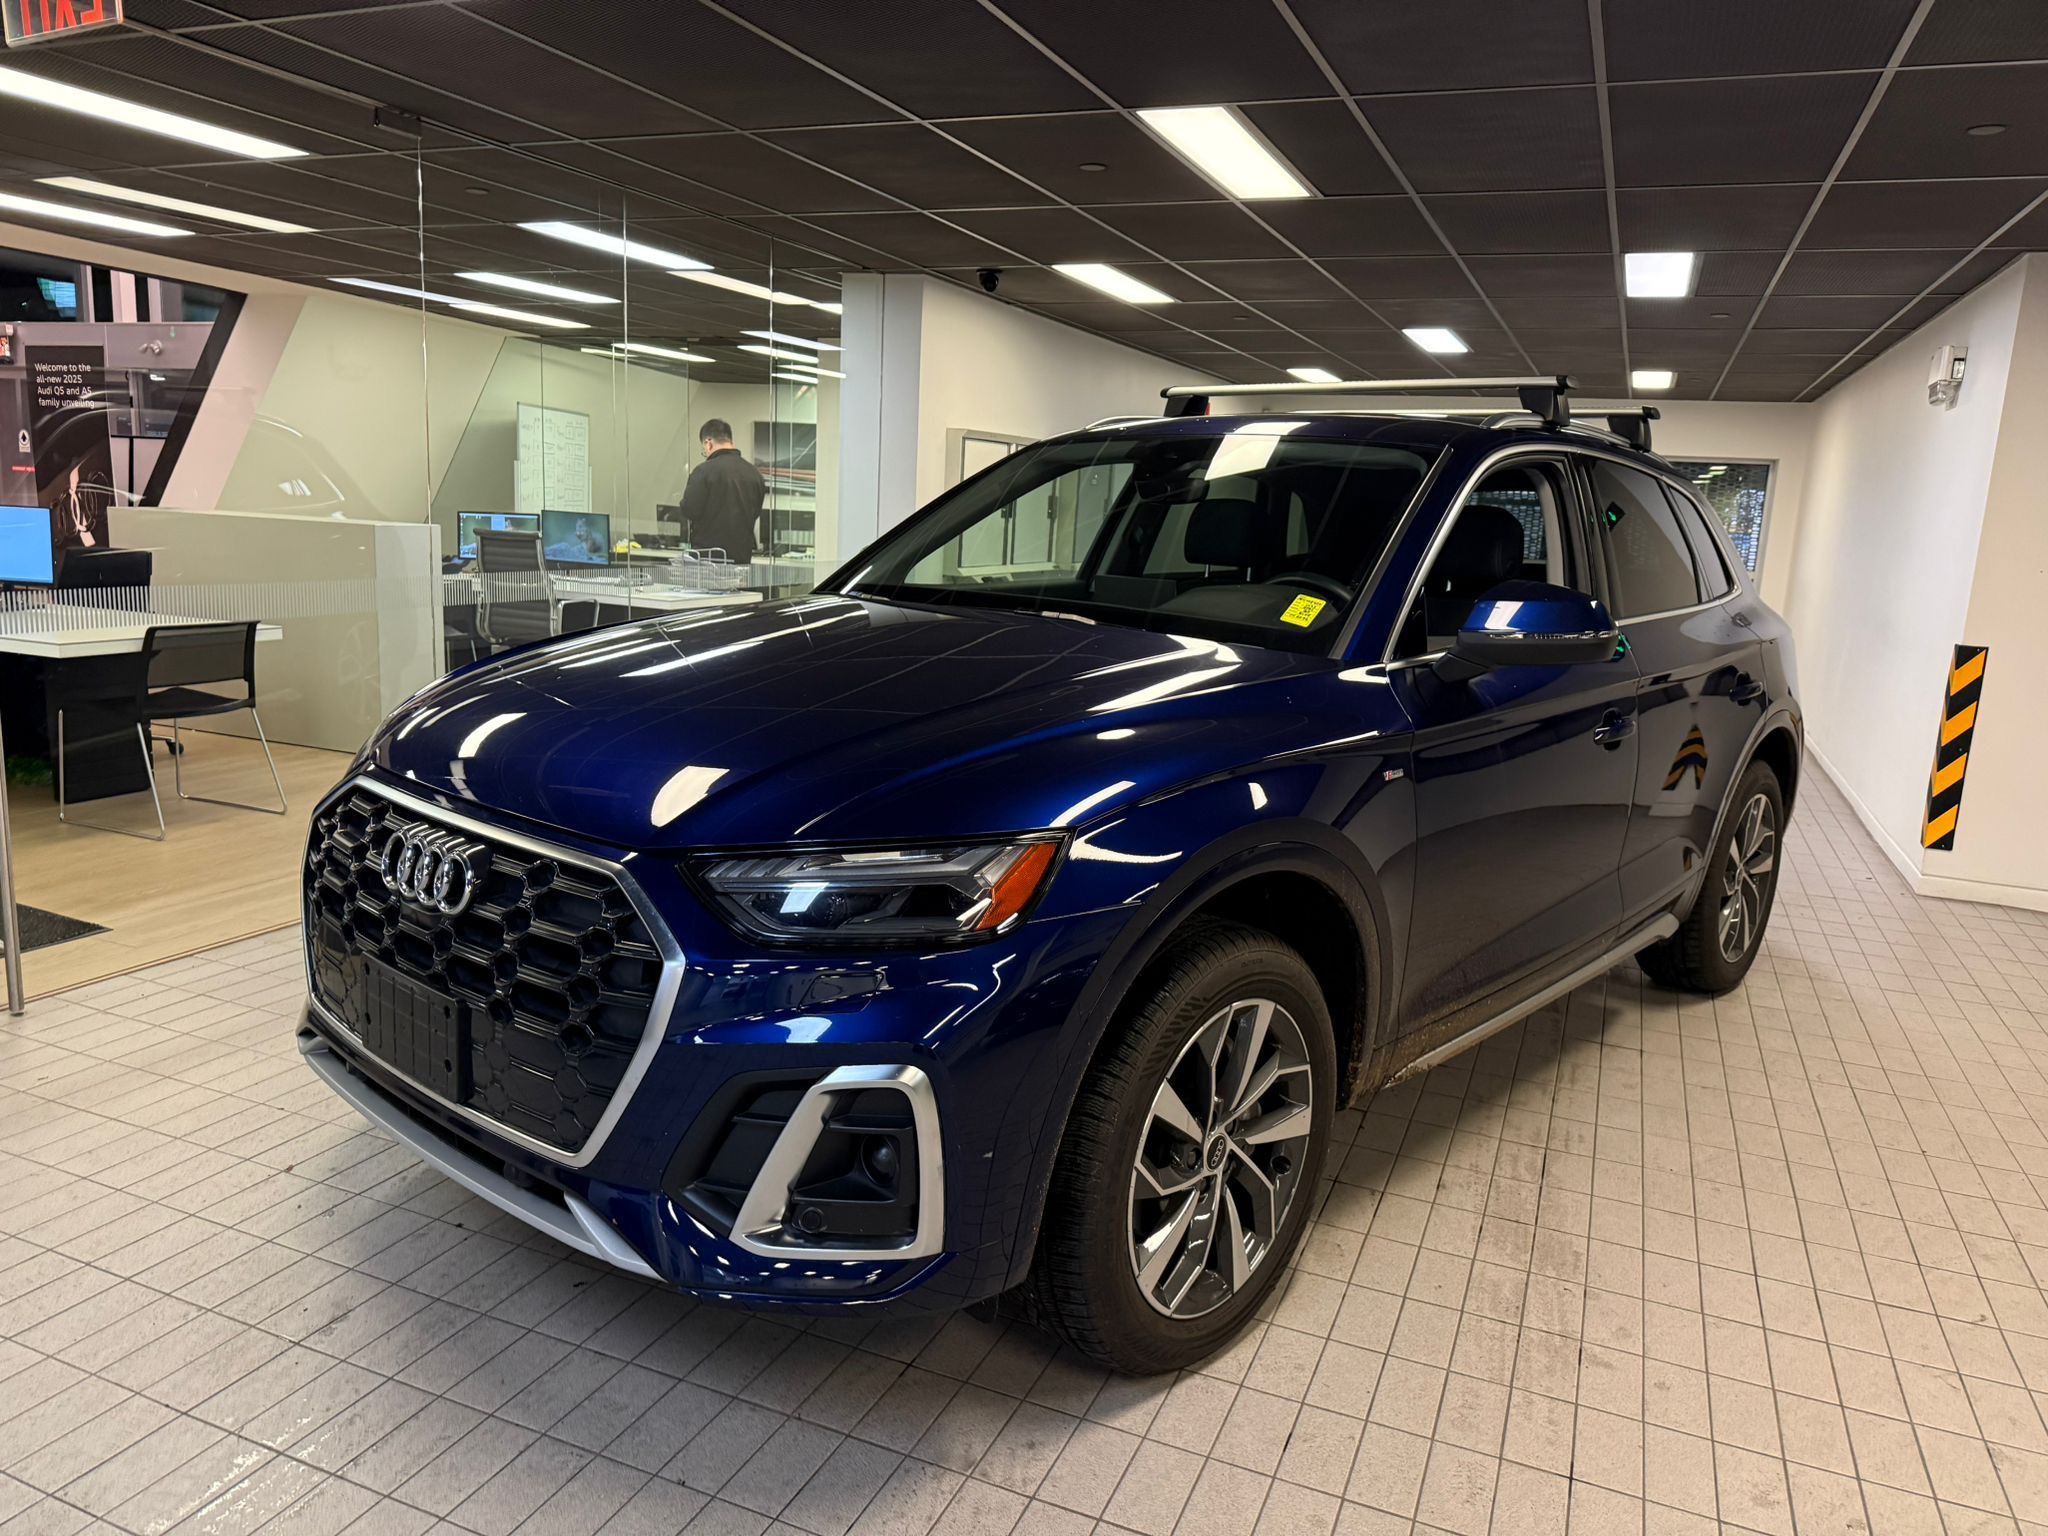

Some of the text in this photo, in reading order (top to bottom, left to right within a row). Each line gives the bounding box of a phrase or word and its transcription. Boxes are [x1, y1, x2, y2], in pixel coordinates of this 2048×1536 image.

[34, 363, 91, 372] Welcome to the
[36, 374, 83, 384] all-new 2025
[37, 386, 53, 395] Audi
[66, 386, 80, 395] and
[38, 397, 95, 409] family unveiling
